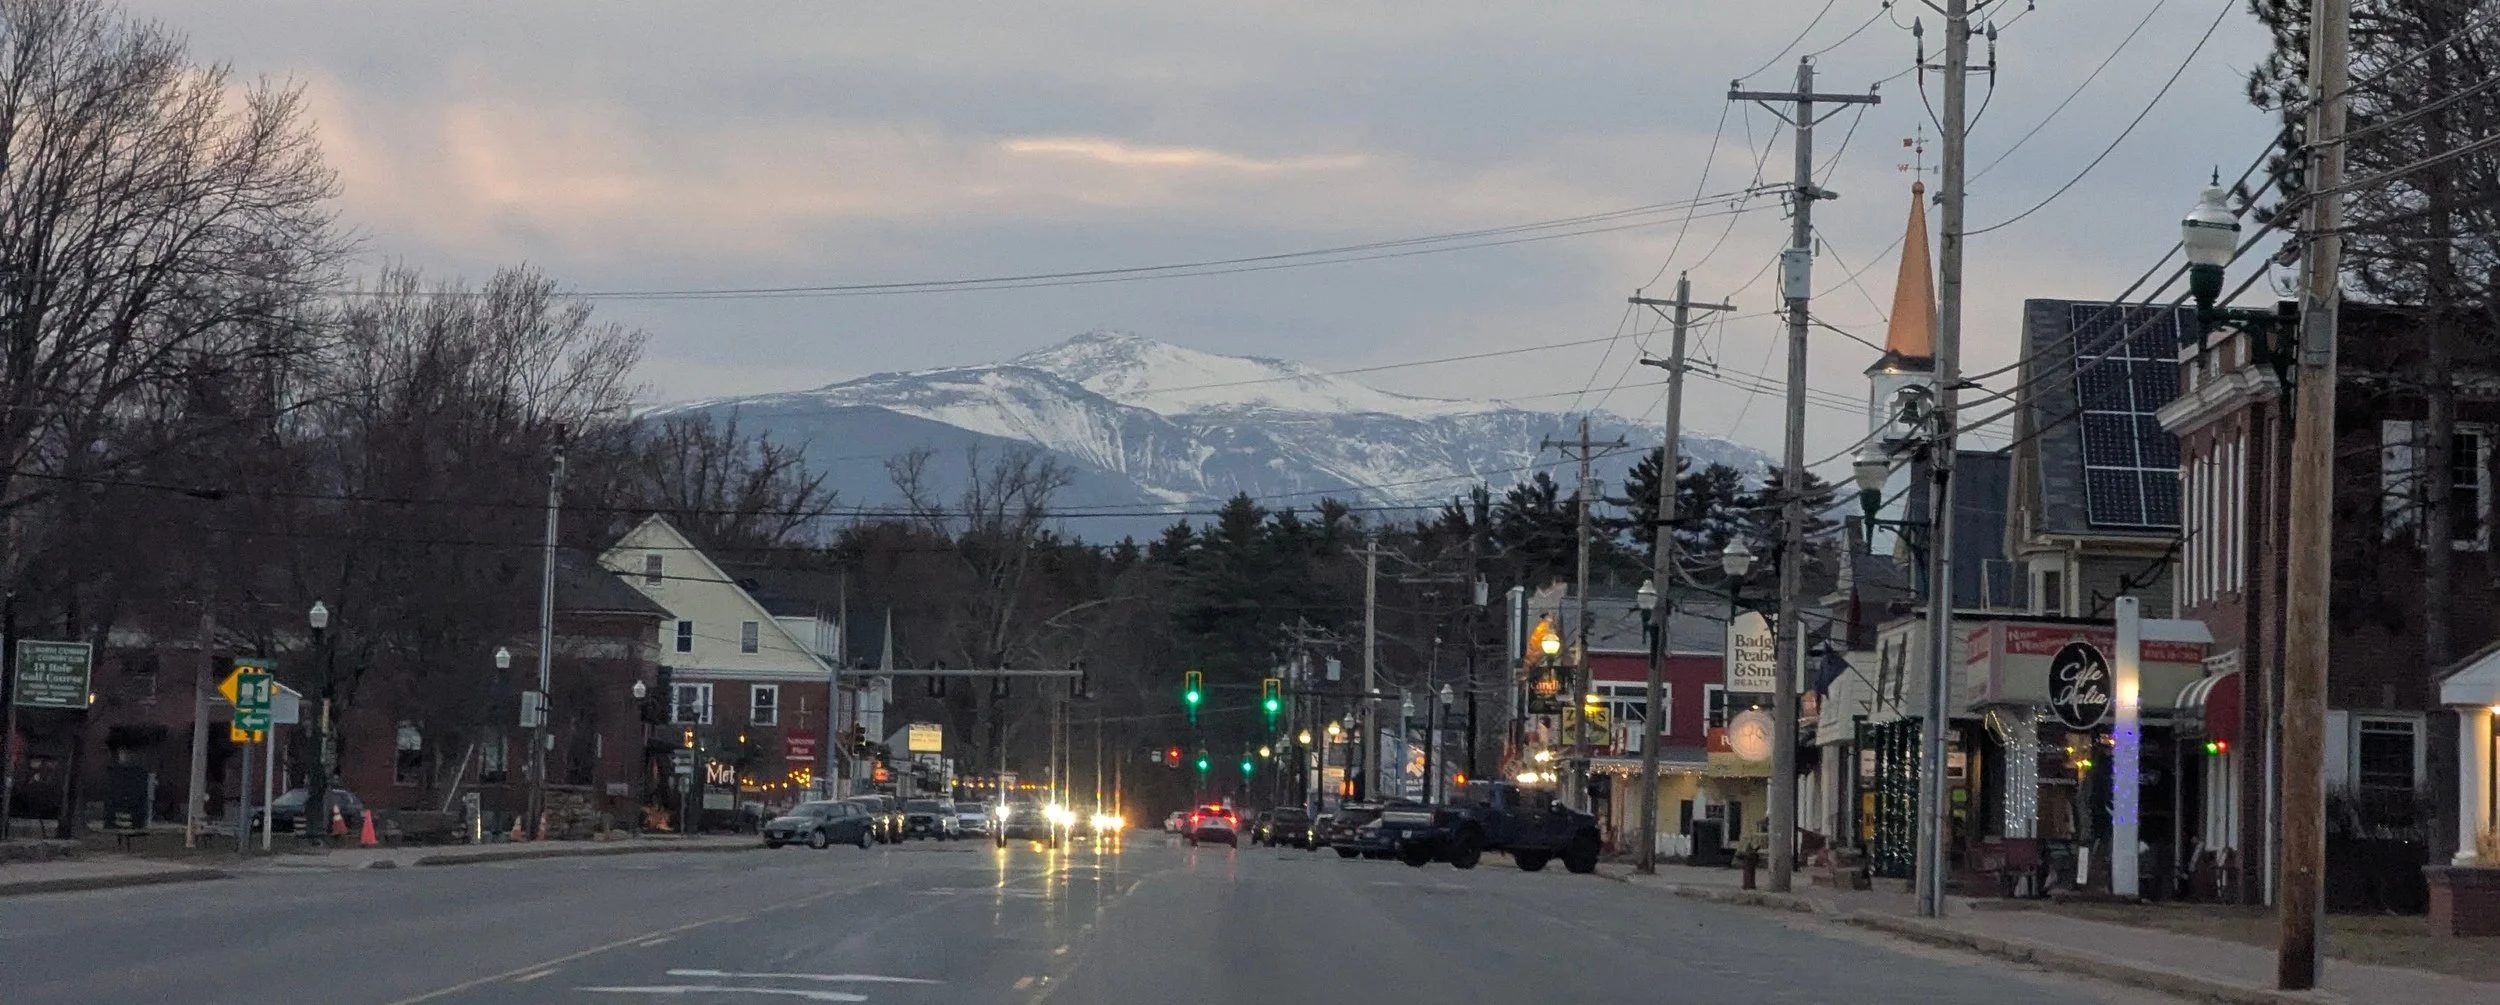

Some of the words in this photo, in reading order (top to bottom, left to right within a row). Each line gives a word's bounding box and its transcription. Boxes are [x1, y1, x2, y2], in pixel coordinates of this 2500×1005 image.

[1735, 634, 1773, 650] Badg
[1735, 649, 1776, 662] Peabo
[33, 662, 46, 672] 18
[49, 663, 73, 673] Hole
[1747, 663, 1776, 677] Smi
[20, 672, 44, 681] Golf
[46, 673, 84, 683] Course
[1734, 679, 1770, 687] REALTY
[705, 763, 737, 785] Met
